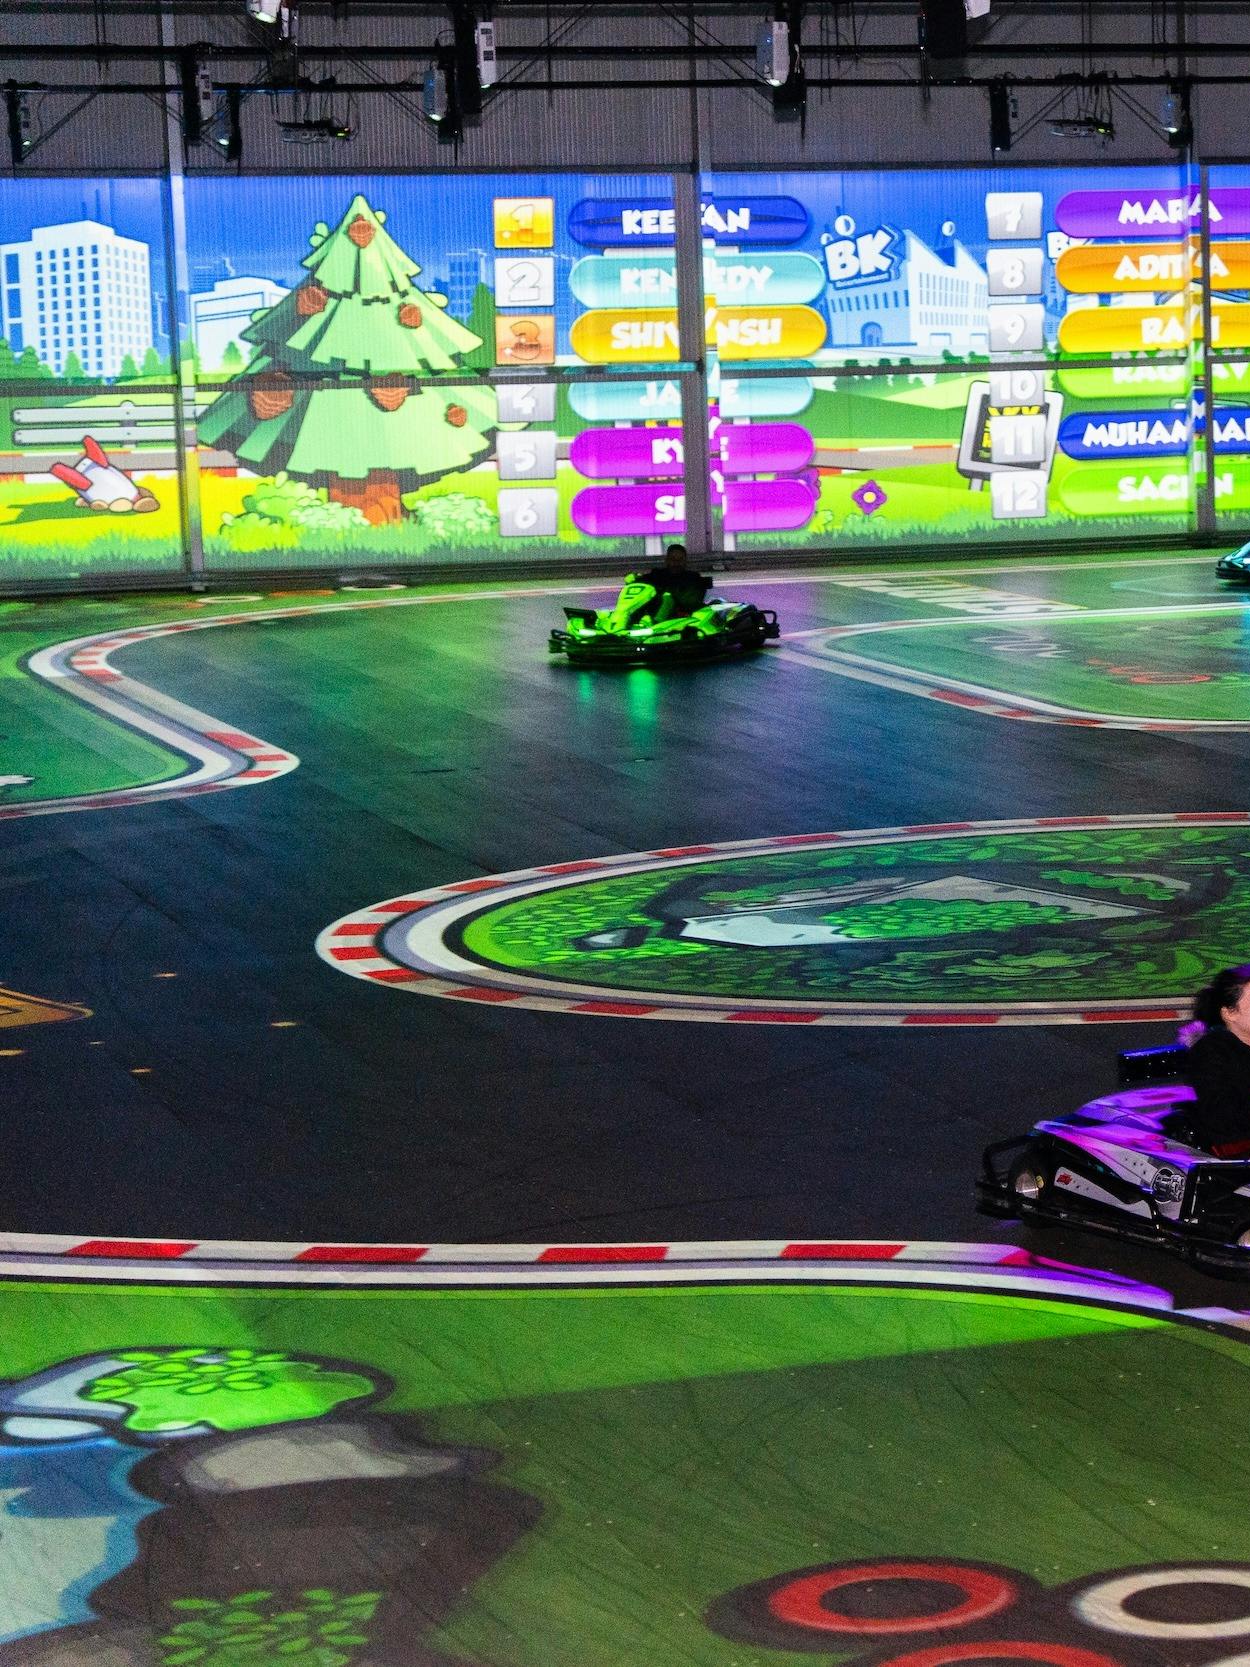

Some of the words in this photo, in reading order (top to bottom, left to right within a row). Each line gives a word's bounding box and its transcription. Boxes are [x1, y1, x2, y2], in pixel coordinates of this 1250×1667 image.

[510, 203, 534, 244] 1
[621, 203, 750, 234] KEEAN
[825, 229, 892, 281] BK
[1046, 231, 1094, 259] B
[506, 261, 541, 302] 2
[1002, 257, 1025, 289] 8
[509, 320, 541, 360] 3
[611, 310, 782, 349] SHIVNSH
[1003, 313, 1026, 344] 9
[512, 382, 536, 415] 4
[995, 370, 1037, 400] 10
[514, 441, 537, 473] 5
[996, 480, 1039, 511] 12
[514, 498, 538, 530] 6
